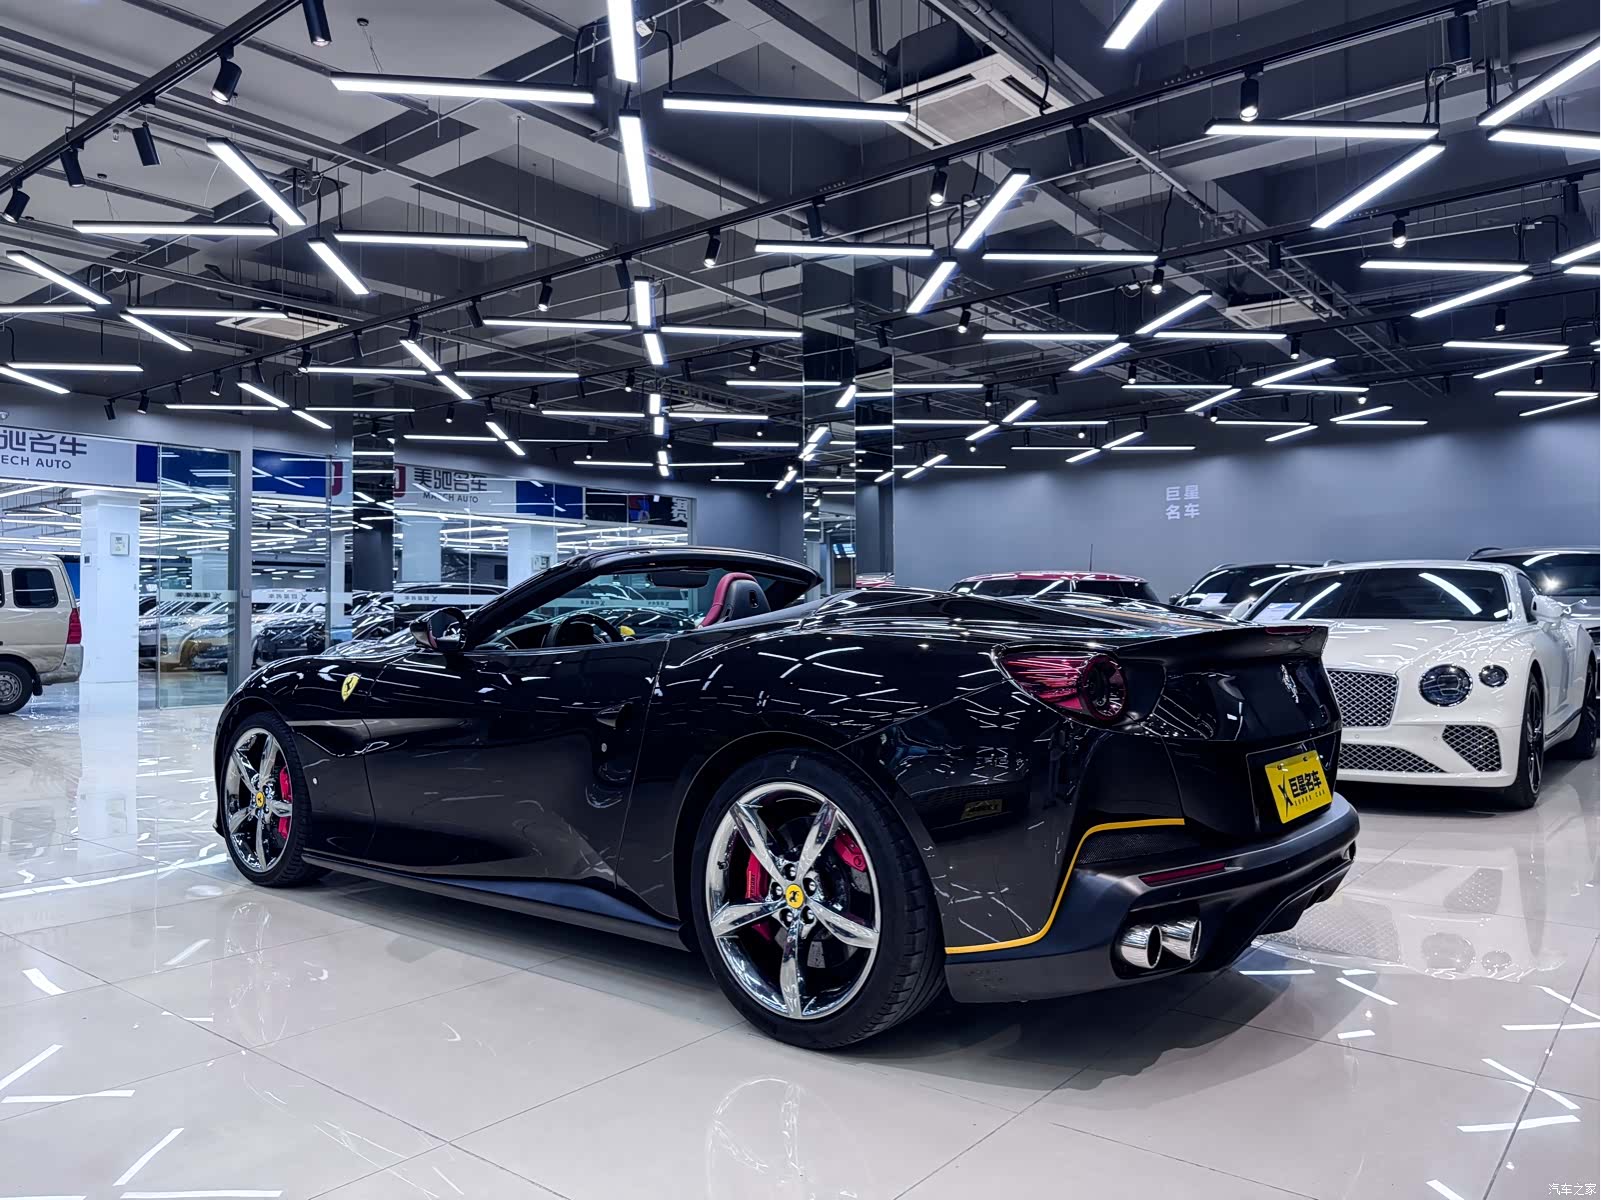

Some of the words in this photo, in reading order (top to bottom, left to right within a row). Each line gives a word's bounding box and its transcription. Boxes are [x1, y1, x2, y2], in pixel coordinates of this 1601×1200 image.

[35, 458, 72, 469] AUTO
[414, 467, 488, 492] 美驰名车
[457, 495, 479, 503] AUTO
[1166, 485, 1200, 501] 巨星
[1166, 503, 1200, 520] 名车
[1288, 770, 1322, 798] 巨星名车
